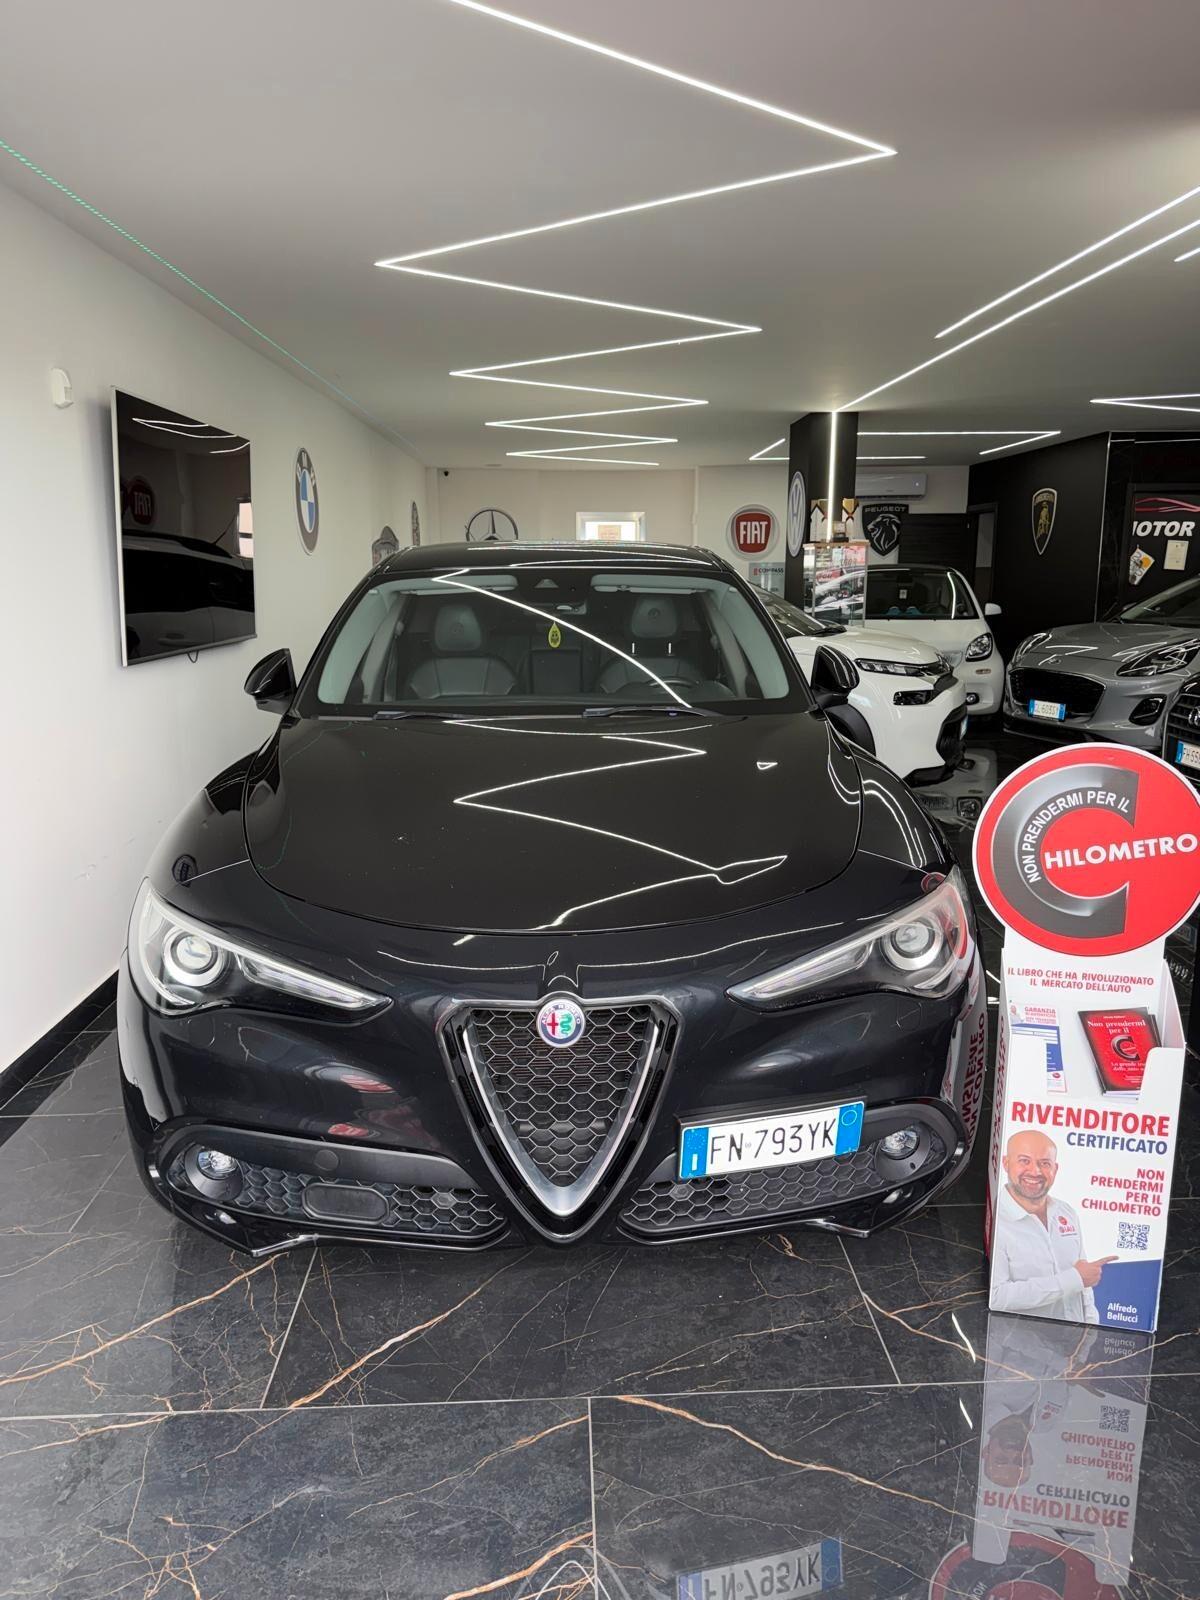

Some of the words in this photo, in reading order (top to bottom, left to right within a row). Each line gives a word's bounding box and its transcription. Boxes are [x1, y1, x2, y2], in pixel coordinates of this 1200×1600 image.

[739, 521, 769, 545] FIAT
[1132, 520, 1196, 537] OTOR
[1087, 790, 1117, 808] PER
[1117, 796, 1130, 814] IL
[1022, 791, 1085, 852] PRENDERMI
[1022, 856, 1042, 884] NON
[1007, 967, 1016, 976] IL
[1017, 968, 1044, 978] LIBRO
[1045, 969, 1063, 980] CHE
[1065, 971, 1078, 980] HA
[1082, 972, 1154, 986] RIVOLUZIONATO
[1030, 978, 1037, 986] IL
[1041, 978, 1084, 990] MERCATO
[1085, 981, 1132, 994] DELL'AUTO
[1087, 1020, 1104, 1028] Non
[1105, 1019, 1147, 1029] prendermi
[1011, 1101, 1170, 1138] RIVENDITORE
[710, 1132, 744, 1165] FN
[754, 1118, 837, 1159] 793YK
[1066, 1131, 1168, 1156] CERTIFICATO
[1136, 1168, 1165, 1181] NON
[1090, 1175, 1164, 1193] PRENDERMI
[1081, 1198, 1161, 1217] CHILOMETRO
[1126, 1192, 1149, 1204] PER
[1151, 1193, 1163, 1205] IL
[1106, 1311, 1138, 1323] Bellucci
[1107, 1302, 1138, 1314] Alfredo
